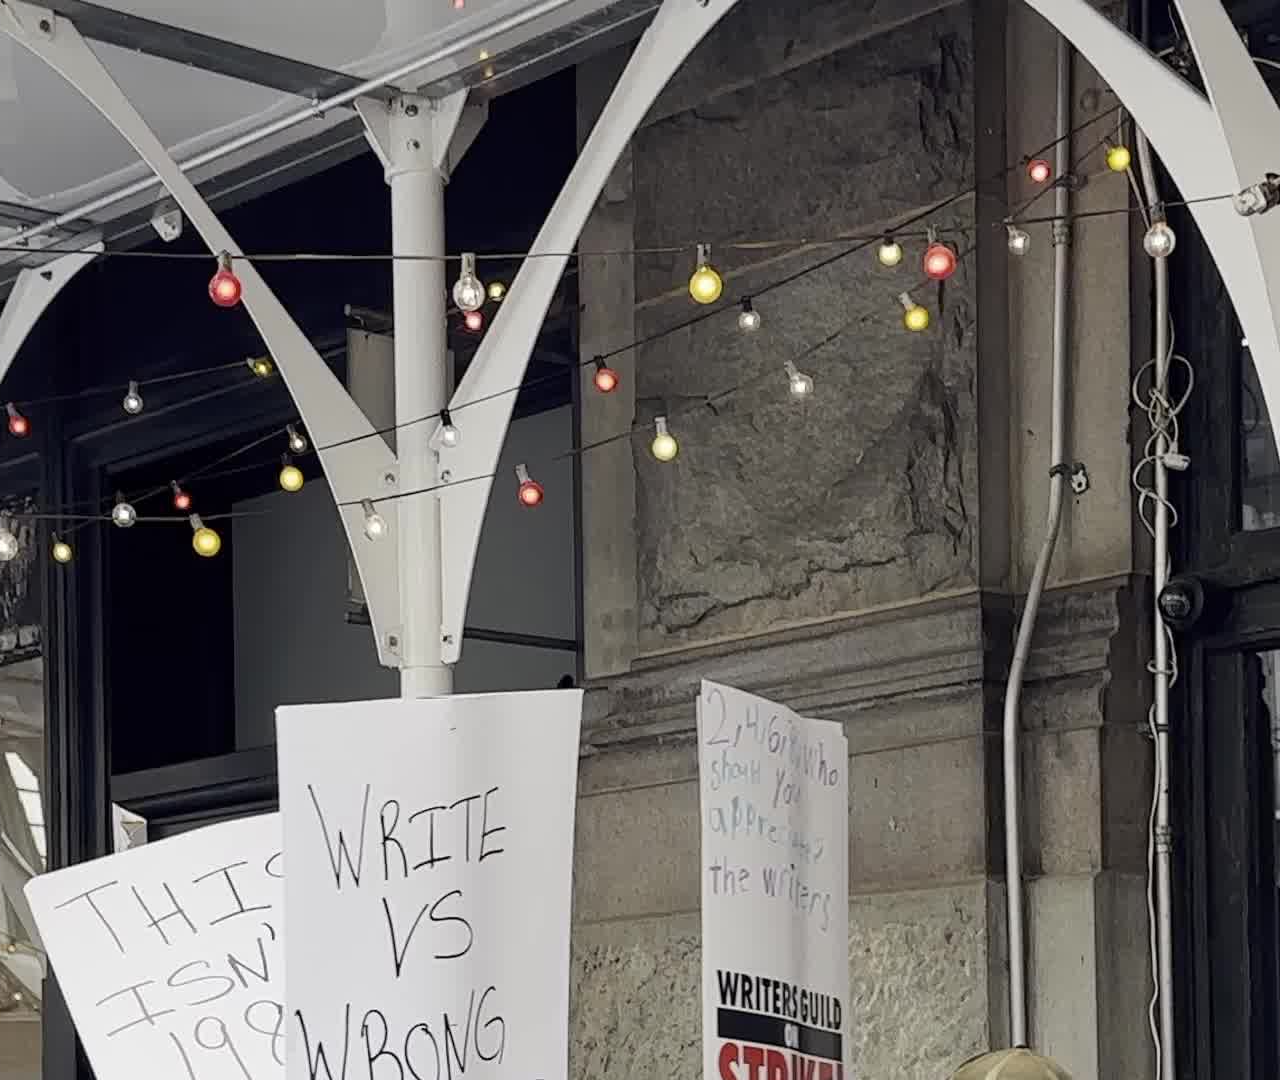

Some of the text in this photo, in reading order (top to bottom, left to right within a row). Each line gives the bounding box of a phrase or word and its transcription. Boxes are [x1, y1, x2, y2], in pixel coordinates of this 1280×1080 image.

[307, 784, 507, 890] WRITE
[382, 890, 473, 978] VS
[717, 969, 842, 1030] WRITERS GUILD
[784, 1023, 800, 1049] ON
